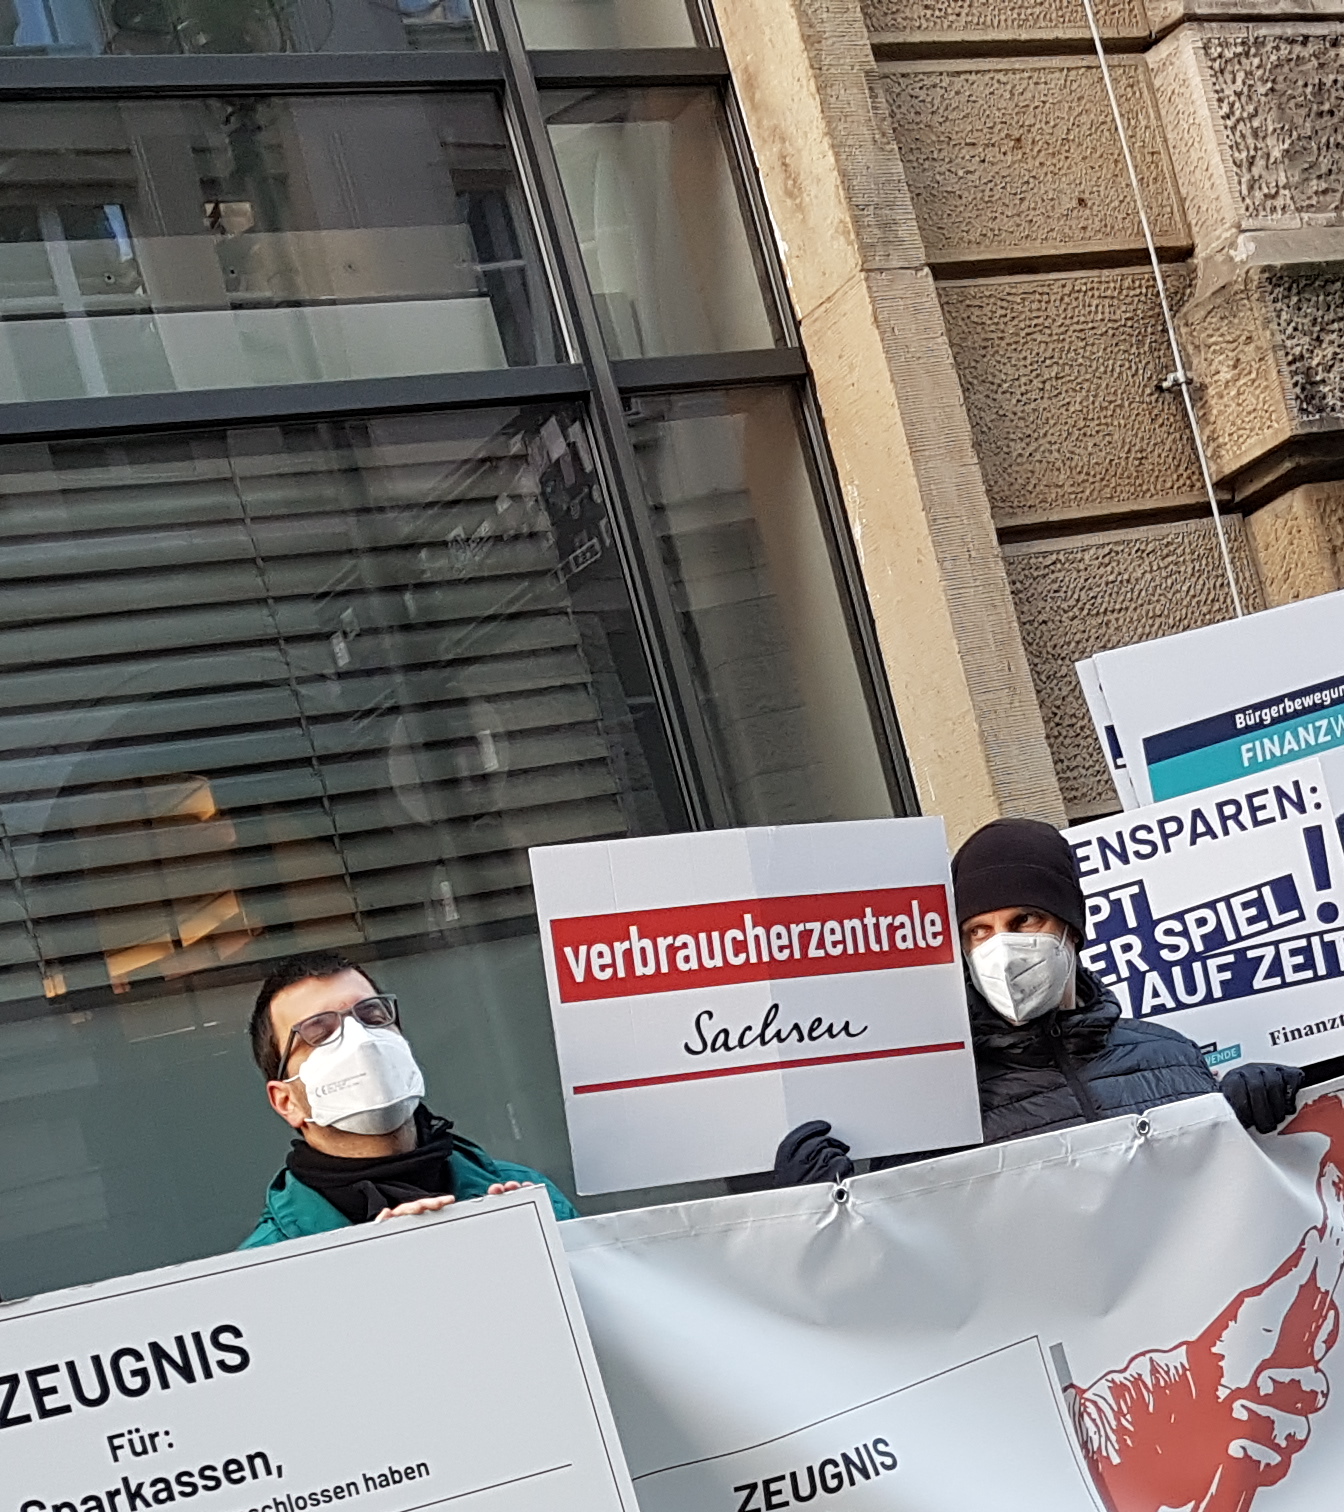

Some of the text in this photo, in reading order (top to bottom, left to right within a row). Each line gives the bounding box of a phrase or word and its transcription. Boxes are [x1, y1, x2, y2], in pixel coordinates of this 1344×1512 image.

[564, 900, 944, 983] verbraucherzentrale
[1154, 889, 1300, 962] SPIEL
[1141, 959, 1232, 1015] AUF
[683, 1003, 868, 1056] Sachsen
[105, 1426, 174, 1464] Für:
[360, 1461, 431, 1493] haben
